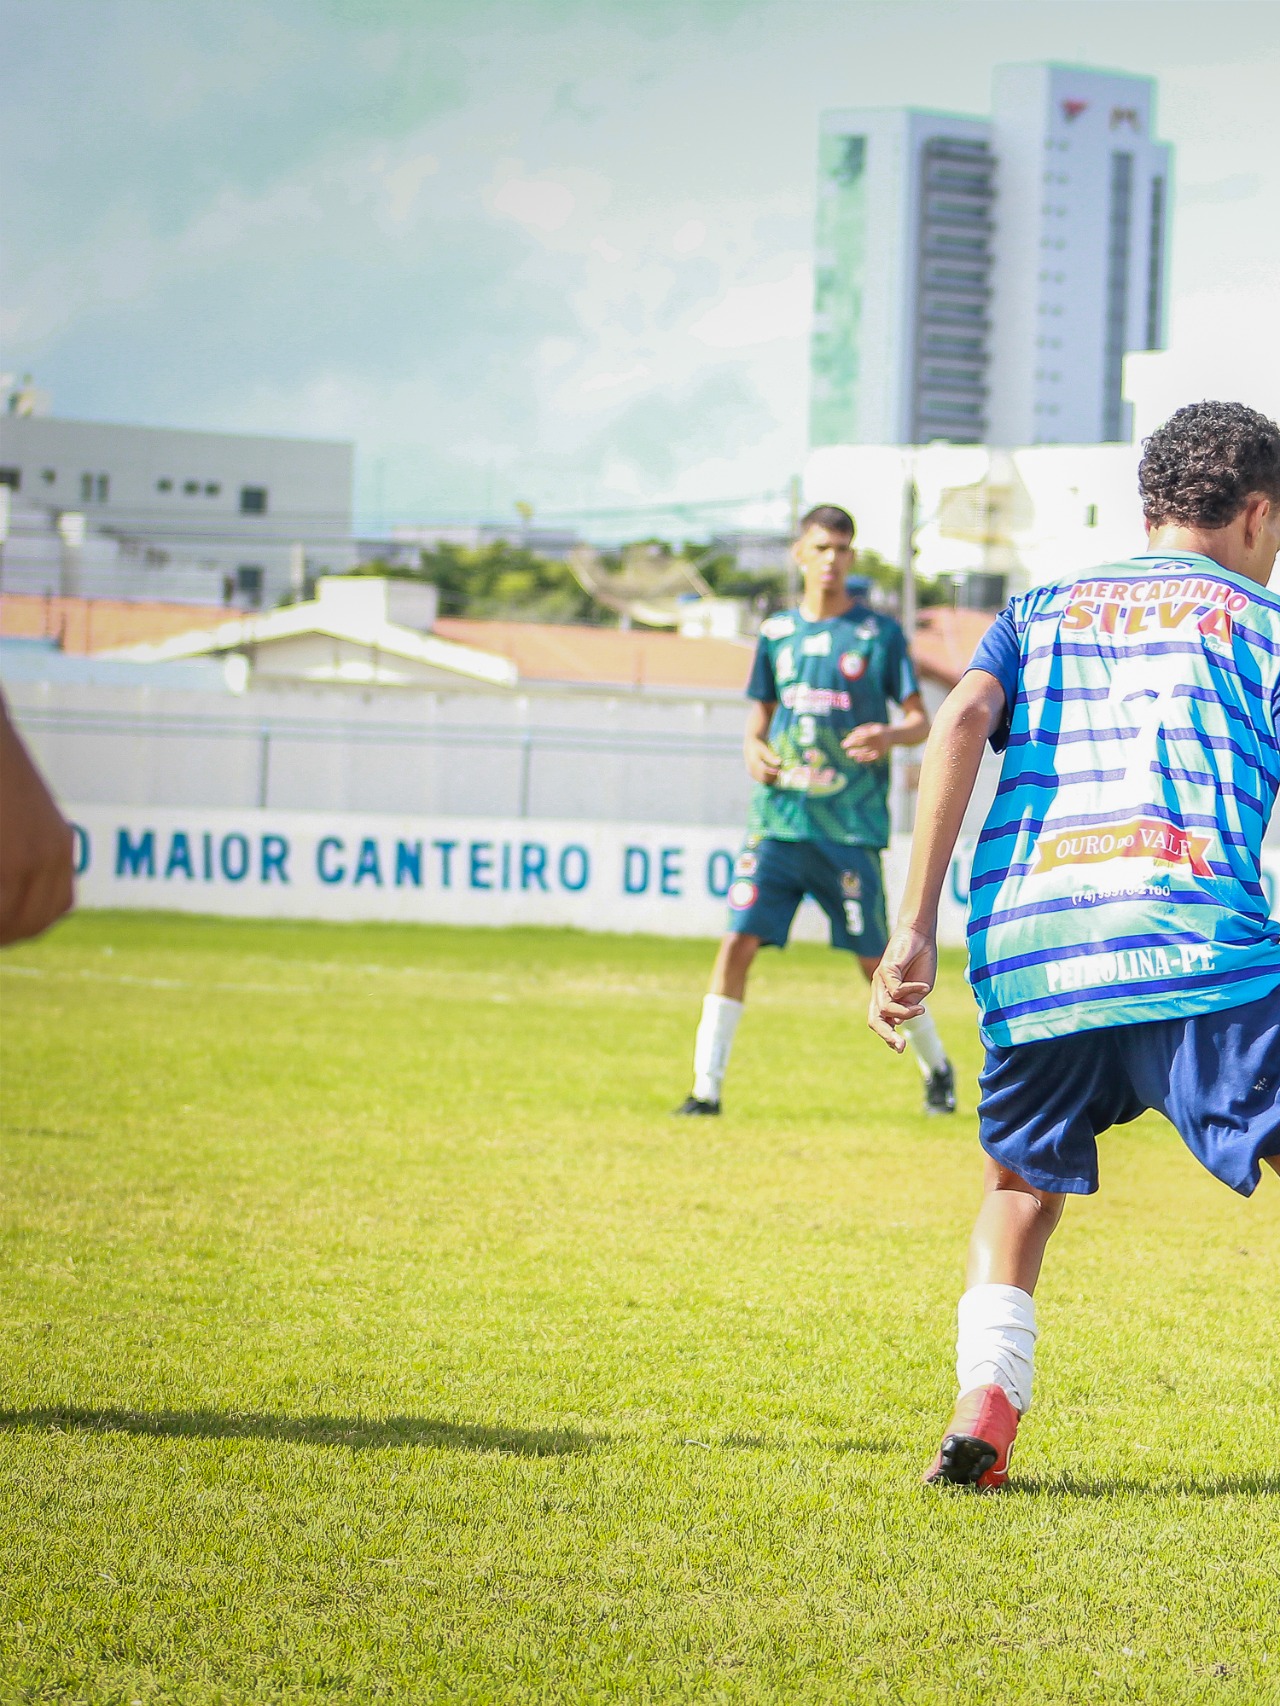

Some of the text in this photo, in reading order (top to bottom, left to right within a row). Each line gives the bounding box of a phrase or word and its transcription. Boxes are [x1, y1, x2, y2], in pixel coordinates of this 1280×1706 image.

[1068, 579, 1249, 612] MERCADINHO
[1061, 600, 1233, 645] SILVA
[115, 827, 291, 883] MAIOR
[315, 836, 590, 892] CANTEIRO
[622, 846, 683, 896] DE
[1055, 834, 1115, 859] OURO
[1138, 827, 1192, 857] VALE
[1044, 944, 1216, 993] PETROLINA-PE
